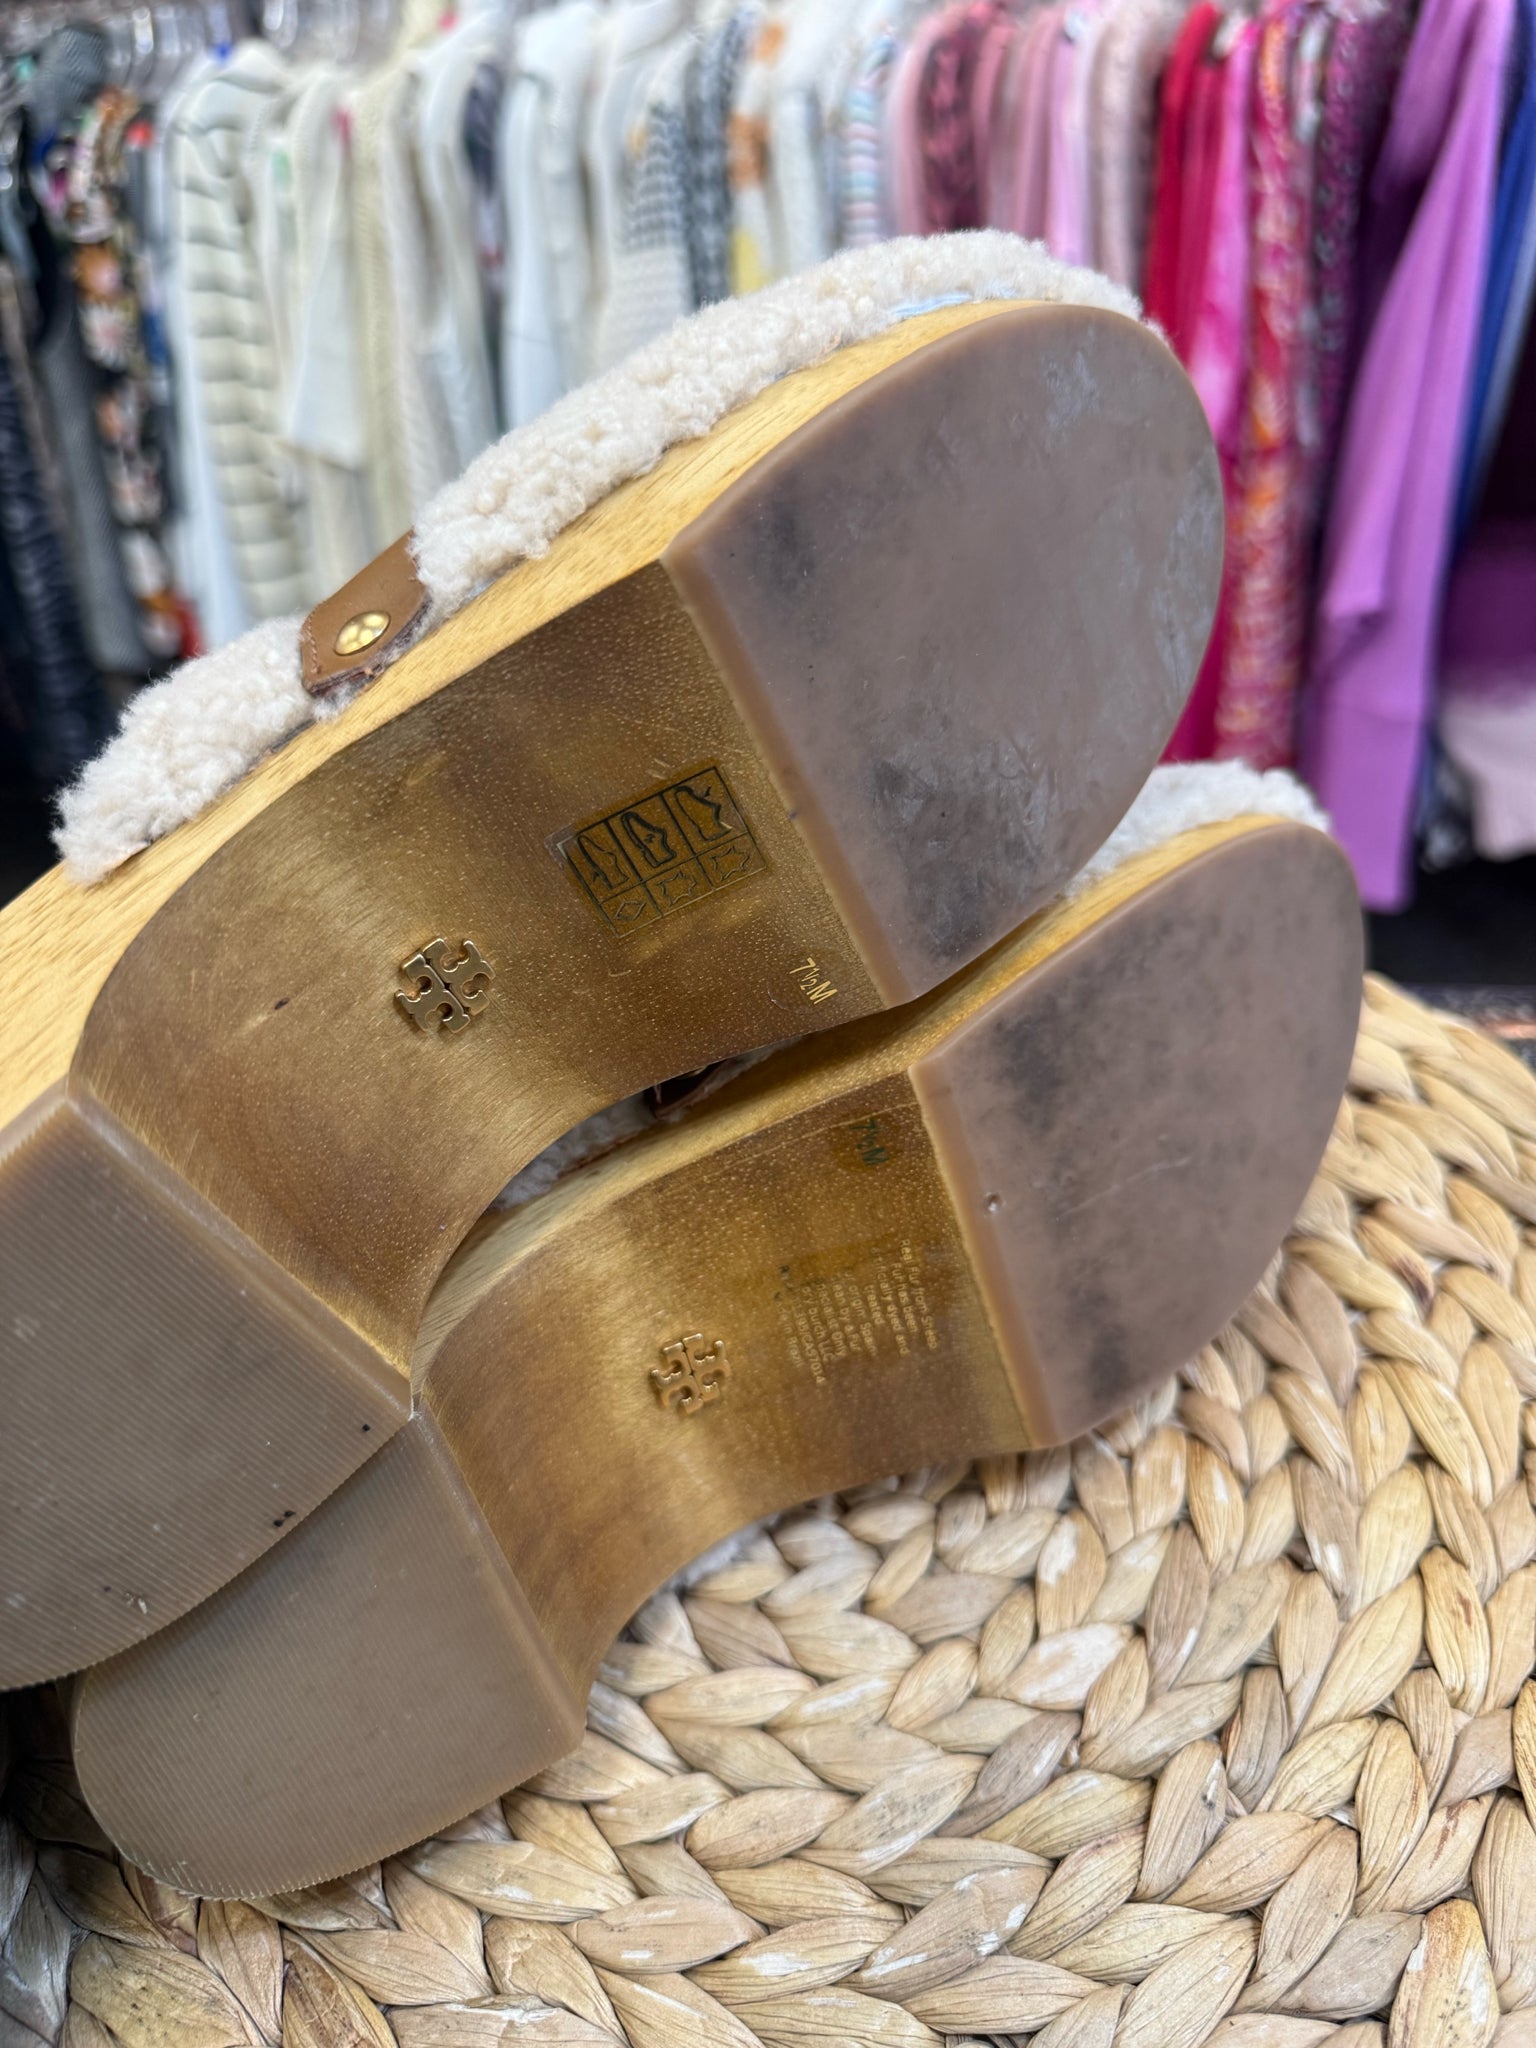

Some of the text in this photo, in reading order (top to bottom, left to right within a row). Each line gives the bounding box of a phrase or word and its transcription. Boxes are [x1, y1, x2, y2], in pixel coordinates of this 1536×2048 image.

[863, 1283, 885, 1325] treated
[901, 1304, 920, 1334] been
[883, 1302, 904, 1332] dyed
[894, 1332, 910, 1356] and
